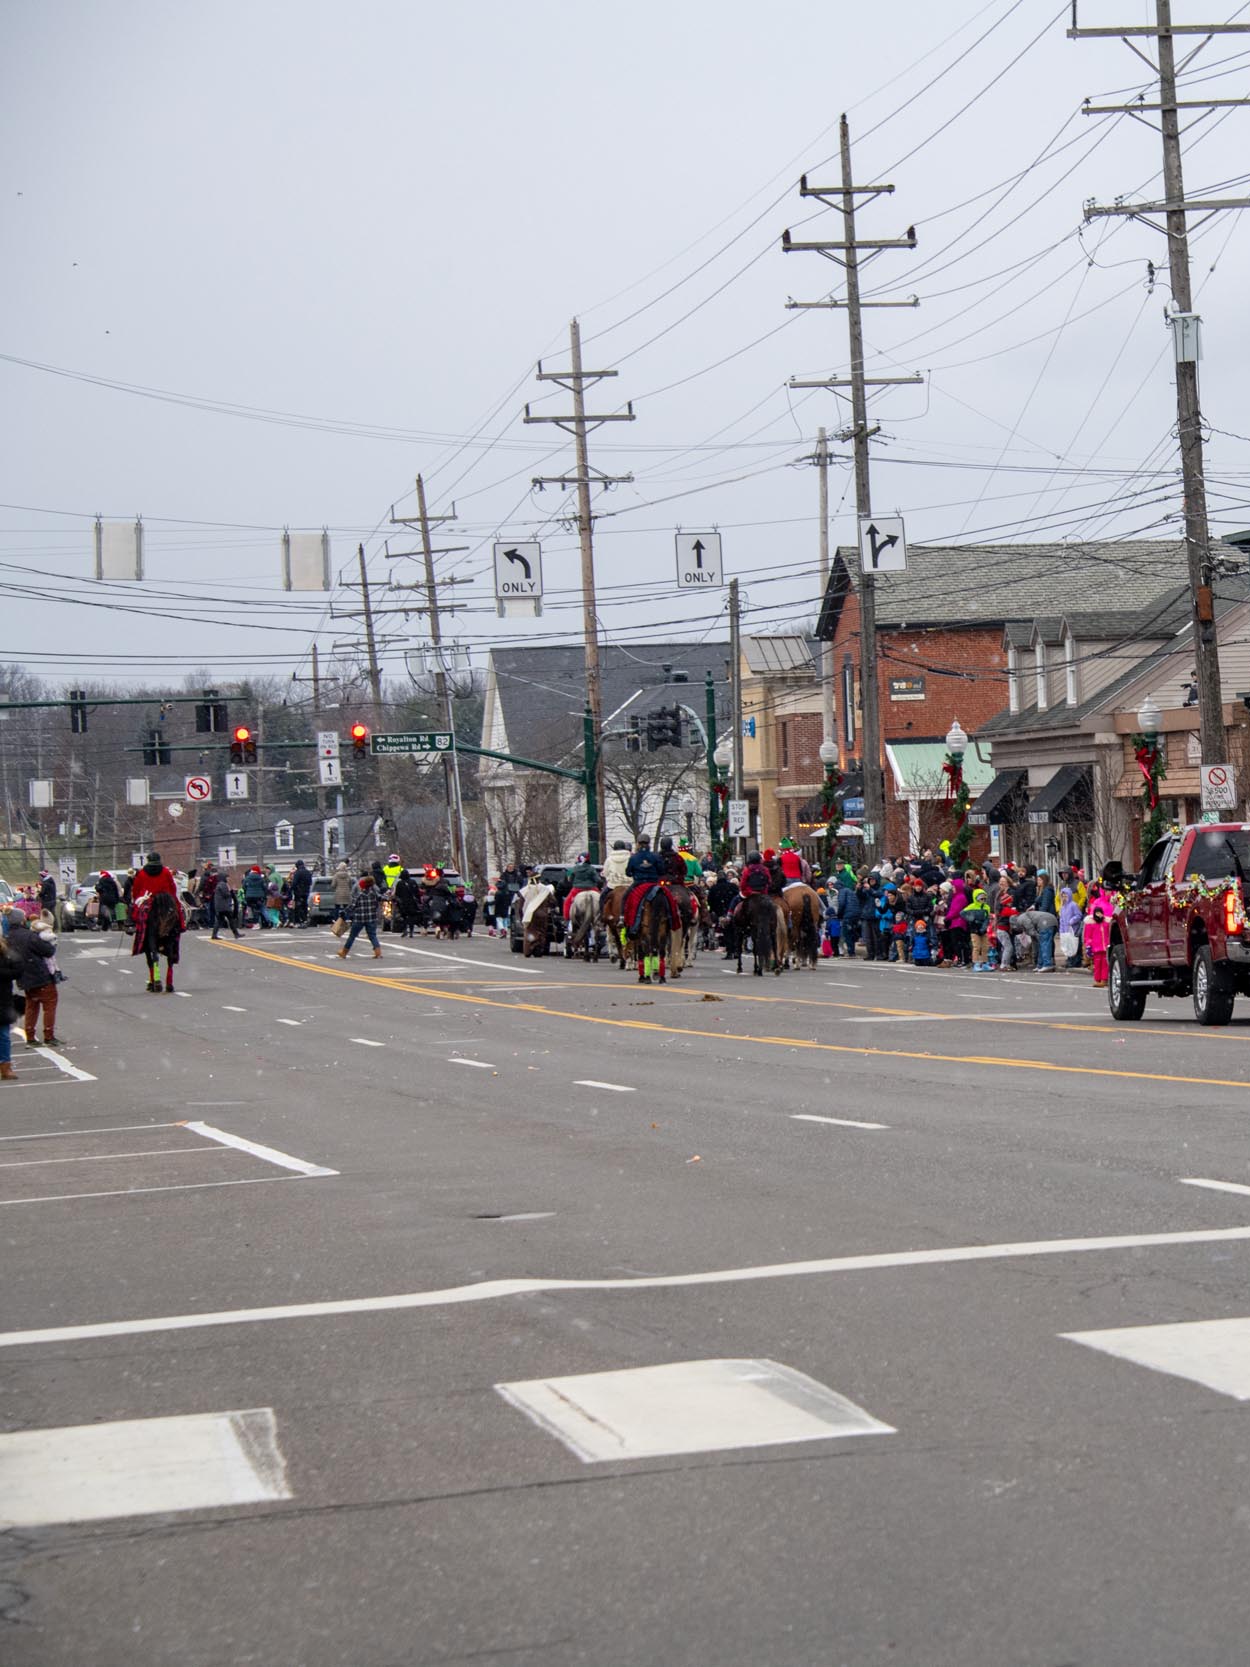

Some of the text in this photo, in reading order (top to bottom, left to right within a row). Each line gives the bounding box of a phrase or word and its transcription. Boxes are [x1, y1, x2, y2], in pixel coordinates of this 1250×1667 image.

[684, 571, 715, 583] ONLY
[502, 582, 536, 593] ONLY
[387, 736, 417, 744] Royalton
[436, 738, 448, 746] 82
[376, 744, 409, 752] Chippewa
